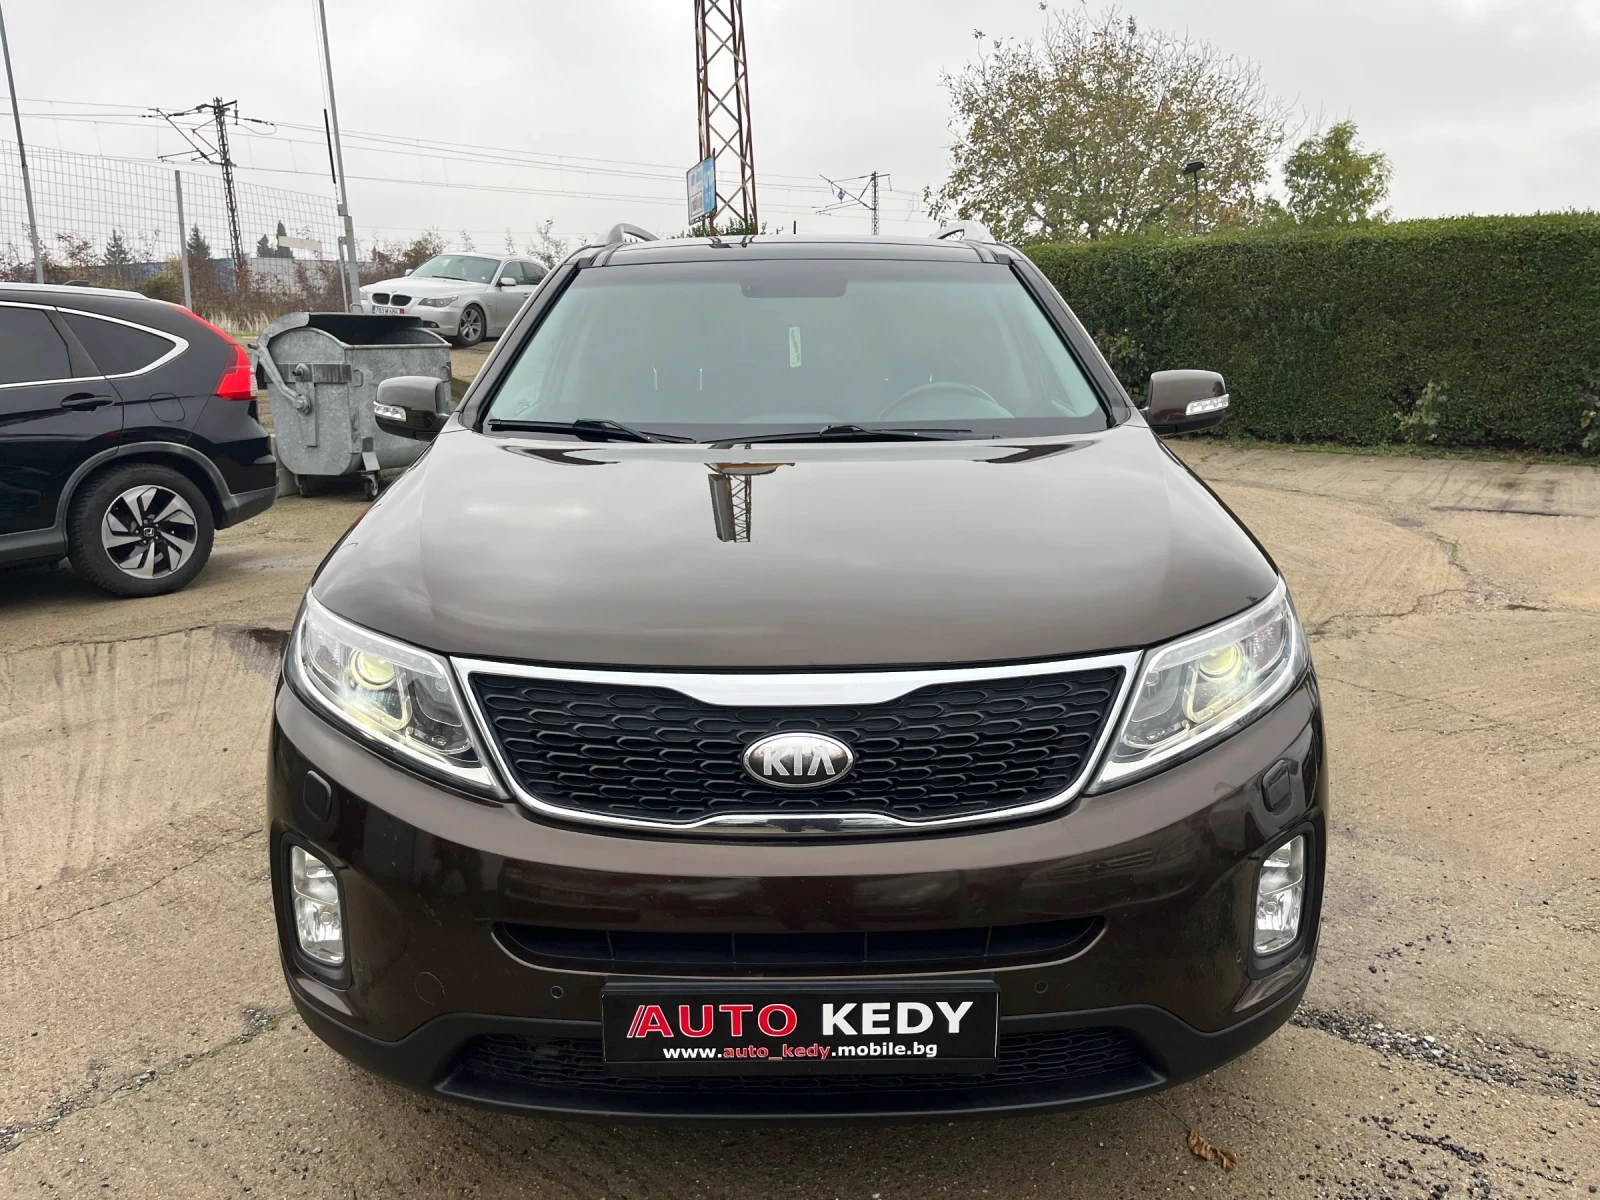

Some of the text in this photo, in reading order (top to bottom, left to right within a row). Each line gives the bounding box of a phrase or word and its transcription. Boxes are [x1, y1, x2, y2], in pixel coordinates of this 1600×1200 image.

[763, 746, 836, 776] KIA
[628, 1001, 974, 1038] AUTO KEDY
[663, 1043, 938, 1061] www.auto_kedy.mobile.bg
